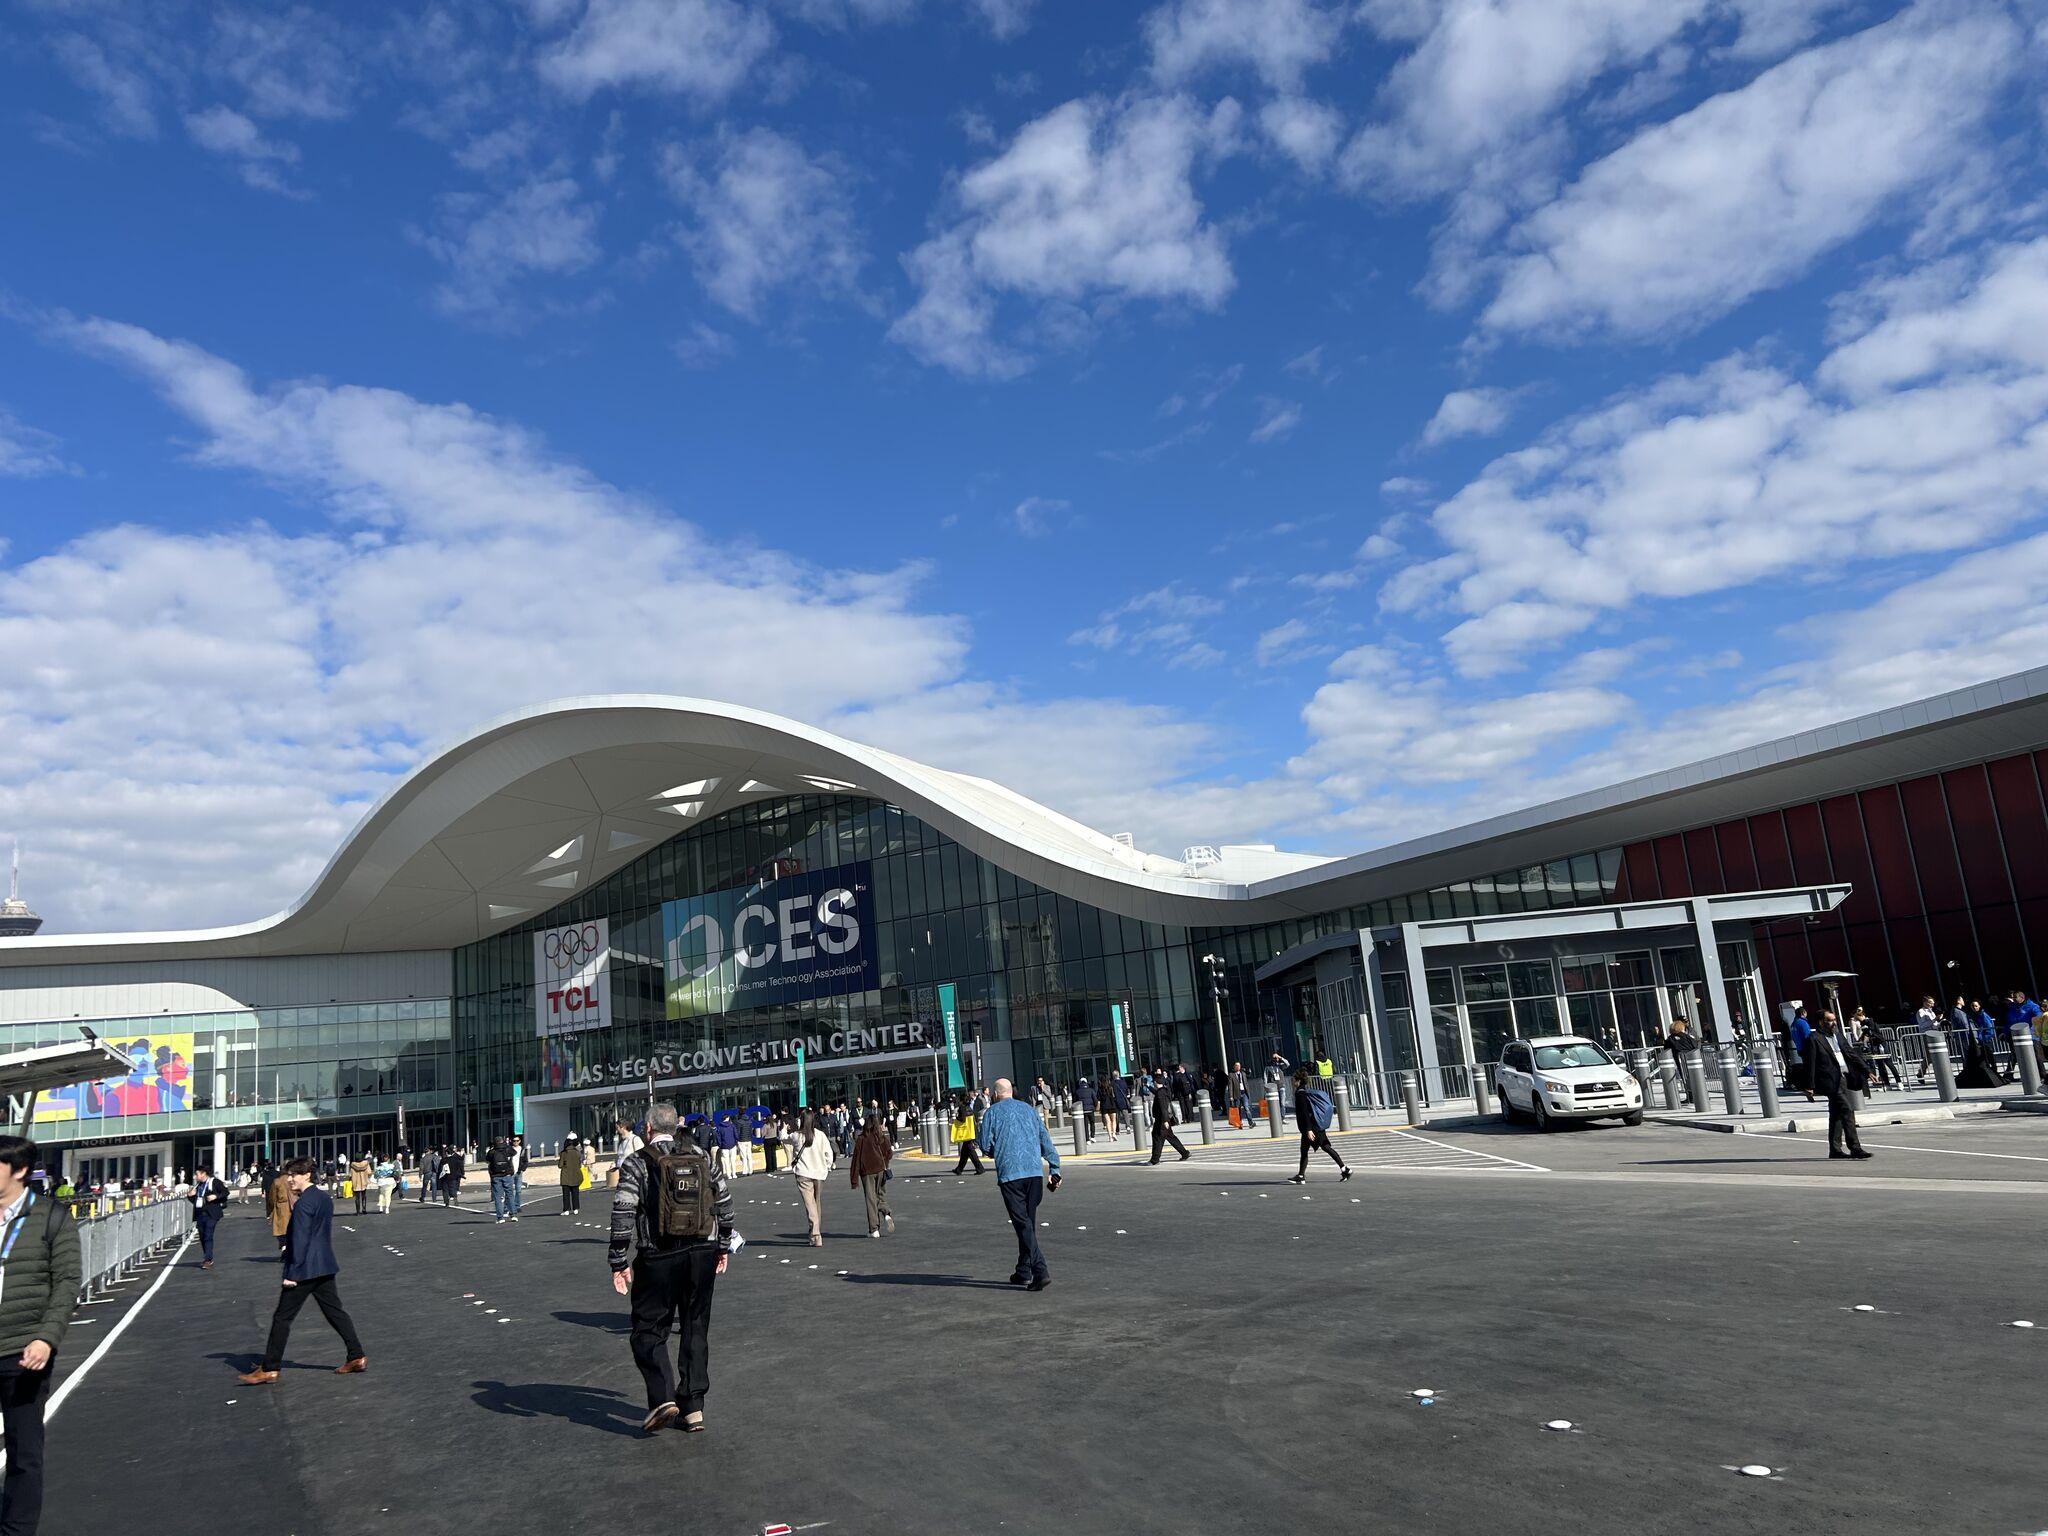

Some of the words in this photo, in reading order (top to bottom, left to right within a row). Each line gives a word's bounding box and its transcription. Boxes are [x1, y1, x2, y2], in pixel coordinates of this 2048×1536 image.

[734, 888, 860, 968] CES
[768, 973, 814, 986] Technoogy
[547, 986, 599, 1013] TCL
[946, 1010, 958, 1060] Hisense
[569, 1064, 604, 1088] LAS
[829, 1022, 924, 1053] CENTER
[81, 1136, 122, 1147] NORTH
[125, 1134, 155, 1144] HALL
